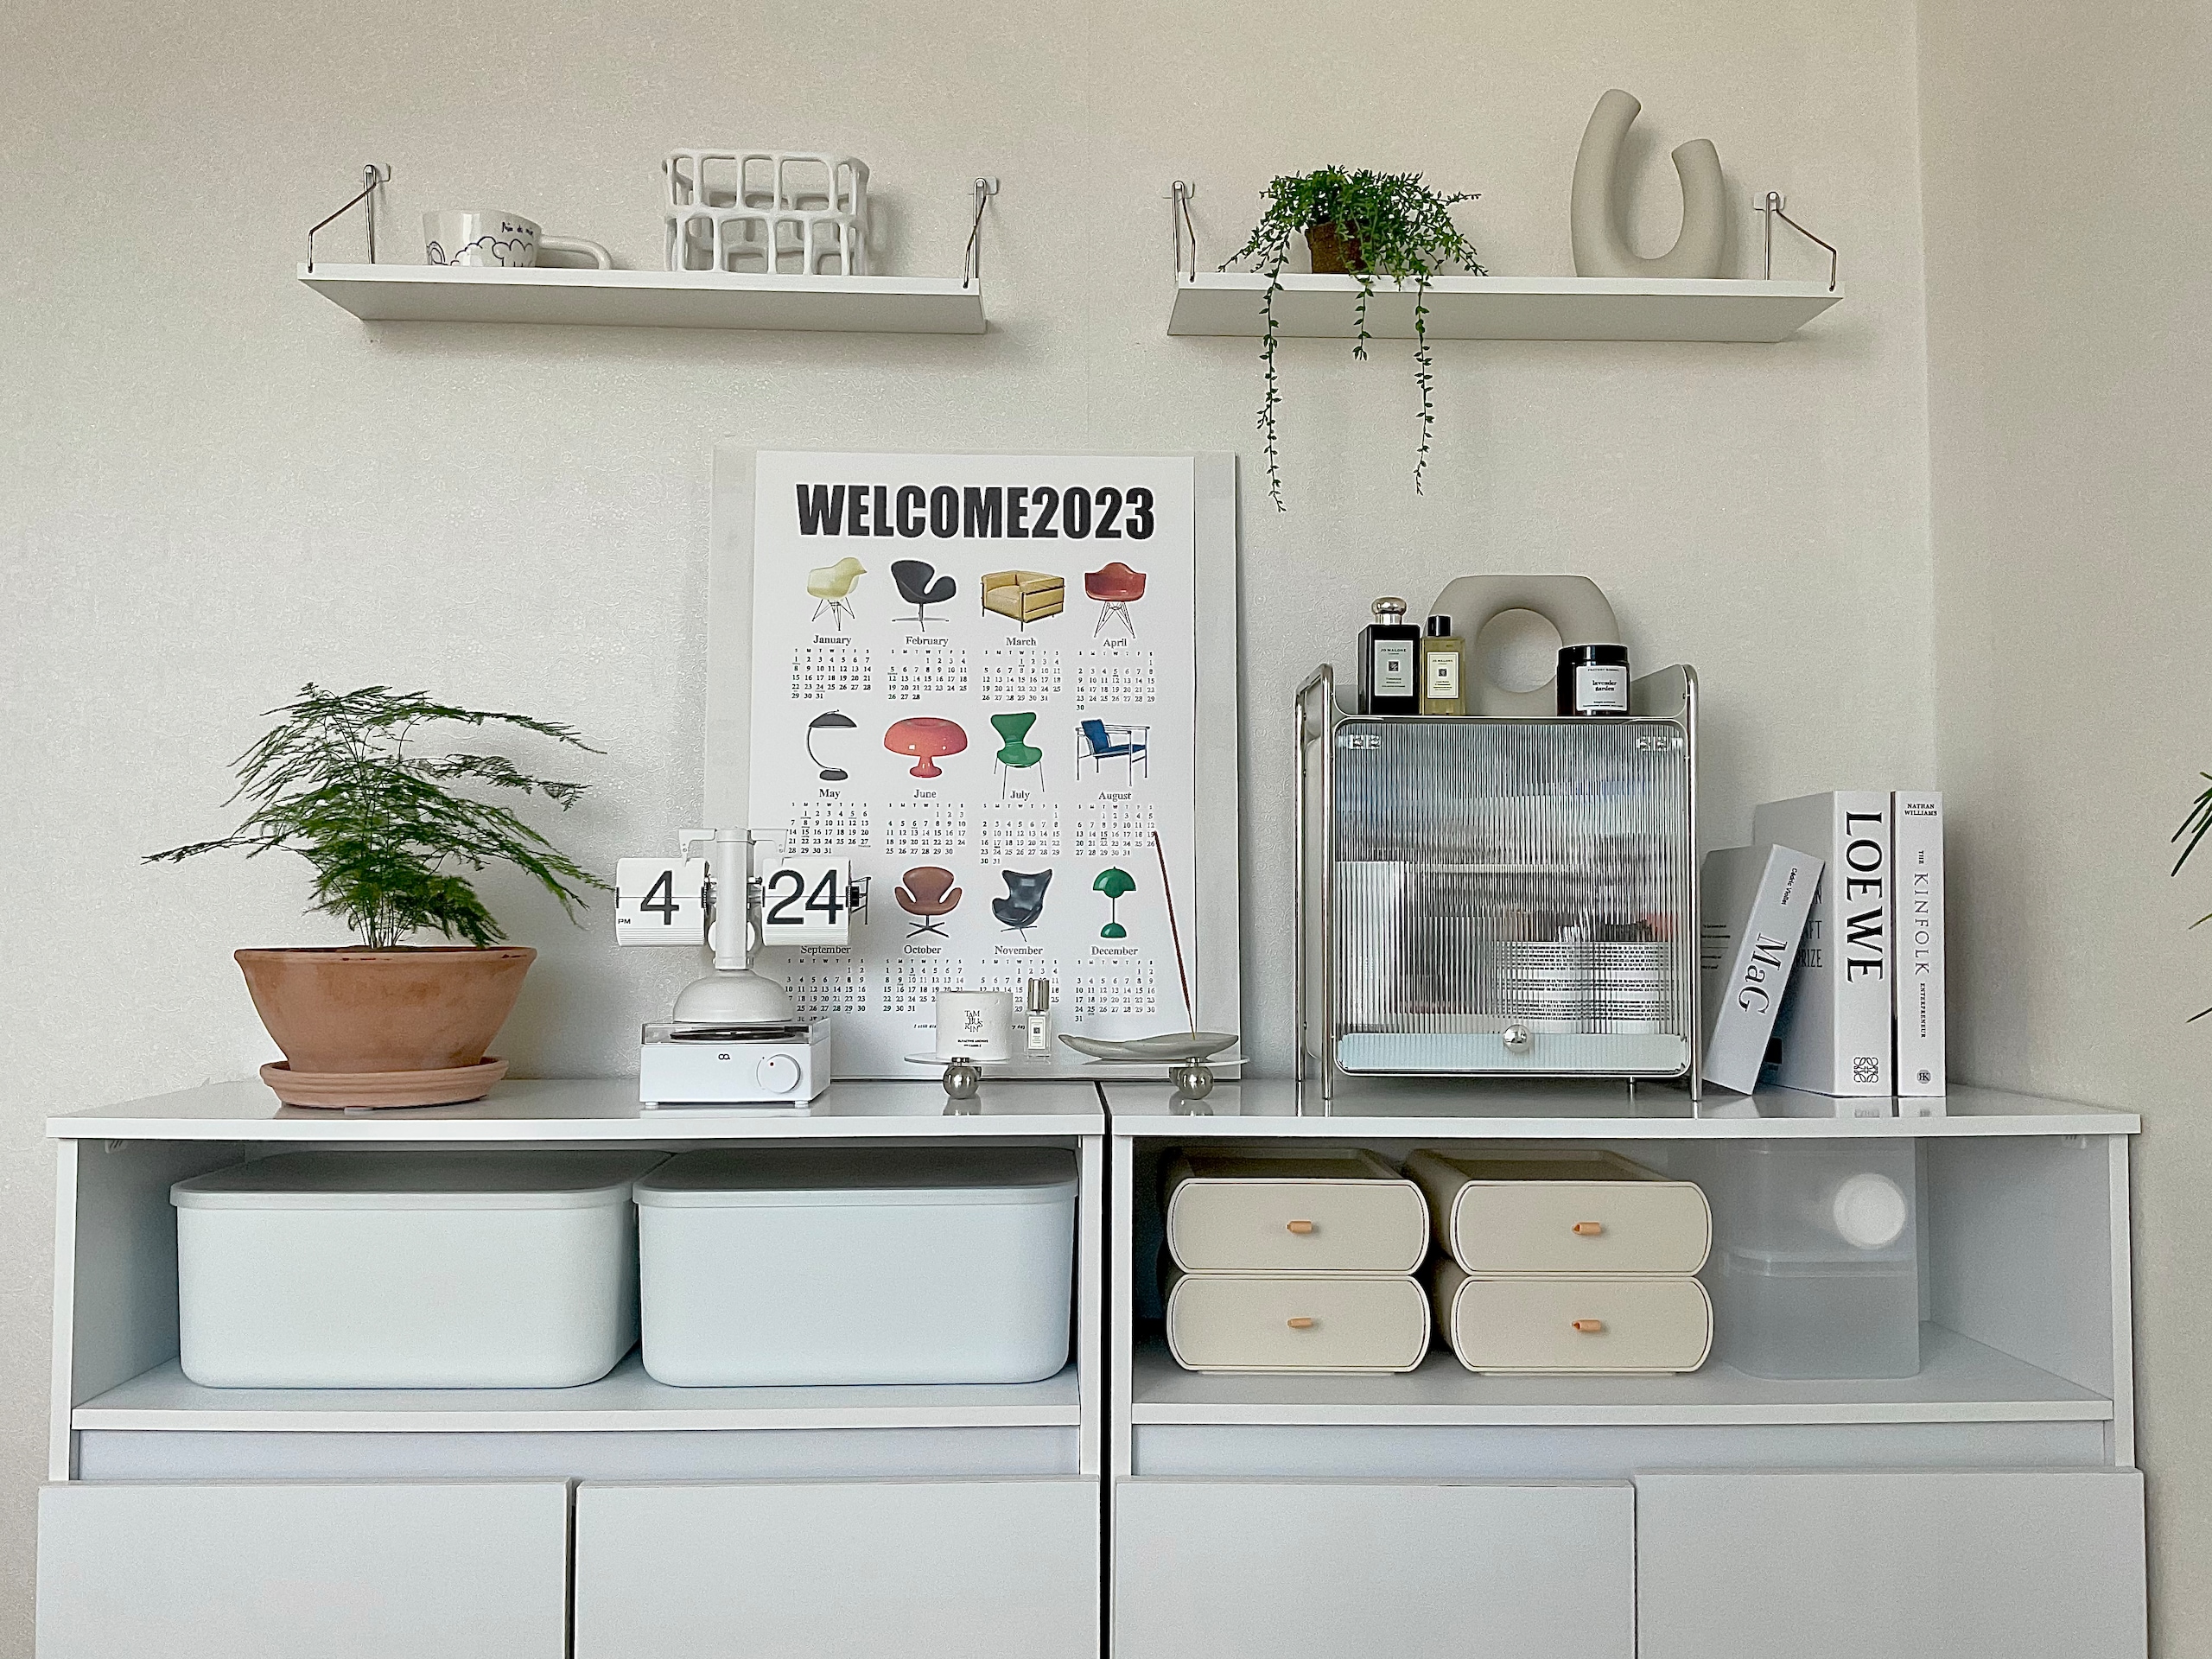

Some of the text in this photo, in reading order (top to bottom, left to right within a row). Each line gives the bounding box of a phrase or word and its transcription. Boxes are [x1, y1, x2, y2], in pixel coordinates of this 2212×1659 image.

[796, 484, 1154, 539] WELCOME2023
[812, 634, 852, 647] January
[905, 635, 950, 648] February
[1006, 637, 1037, 646] March
[1103, 638, 1128, 649] April
[818, 788, 841, 800] May
[913, 789, 937, 798] June
[1009, 790, 1031, 802] July
[1097, 791, 1132, 803] August
[640, 870, 679, 925] 4
[766, 869, 844, 925] 24
[1847, 811, 1883, 982] LOEWE
[1914, 872, 1929, 976] KINFOLK
[800, 945, 852, 957] September
[903, 944, 942, 955] October
[994, 945, 1044, 956] November
[1090, 945, 1139, 956] December
[1738, 933, 1788, 1014] MaG
